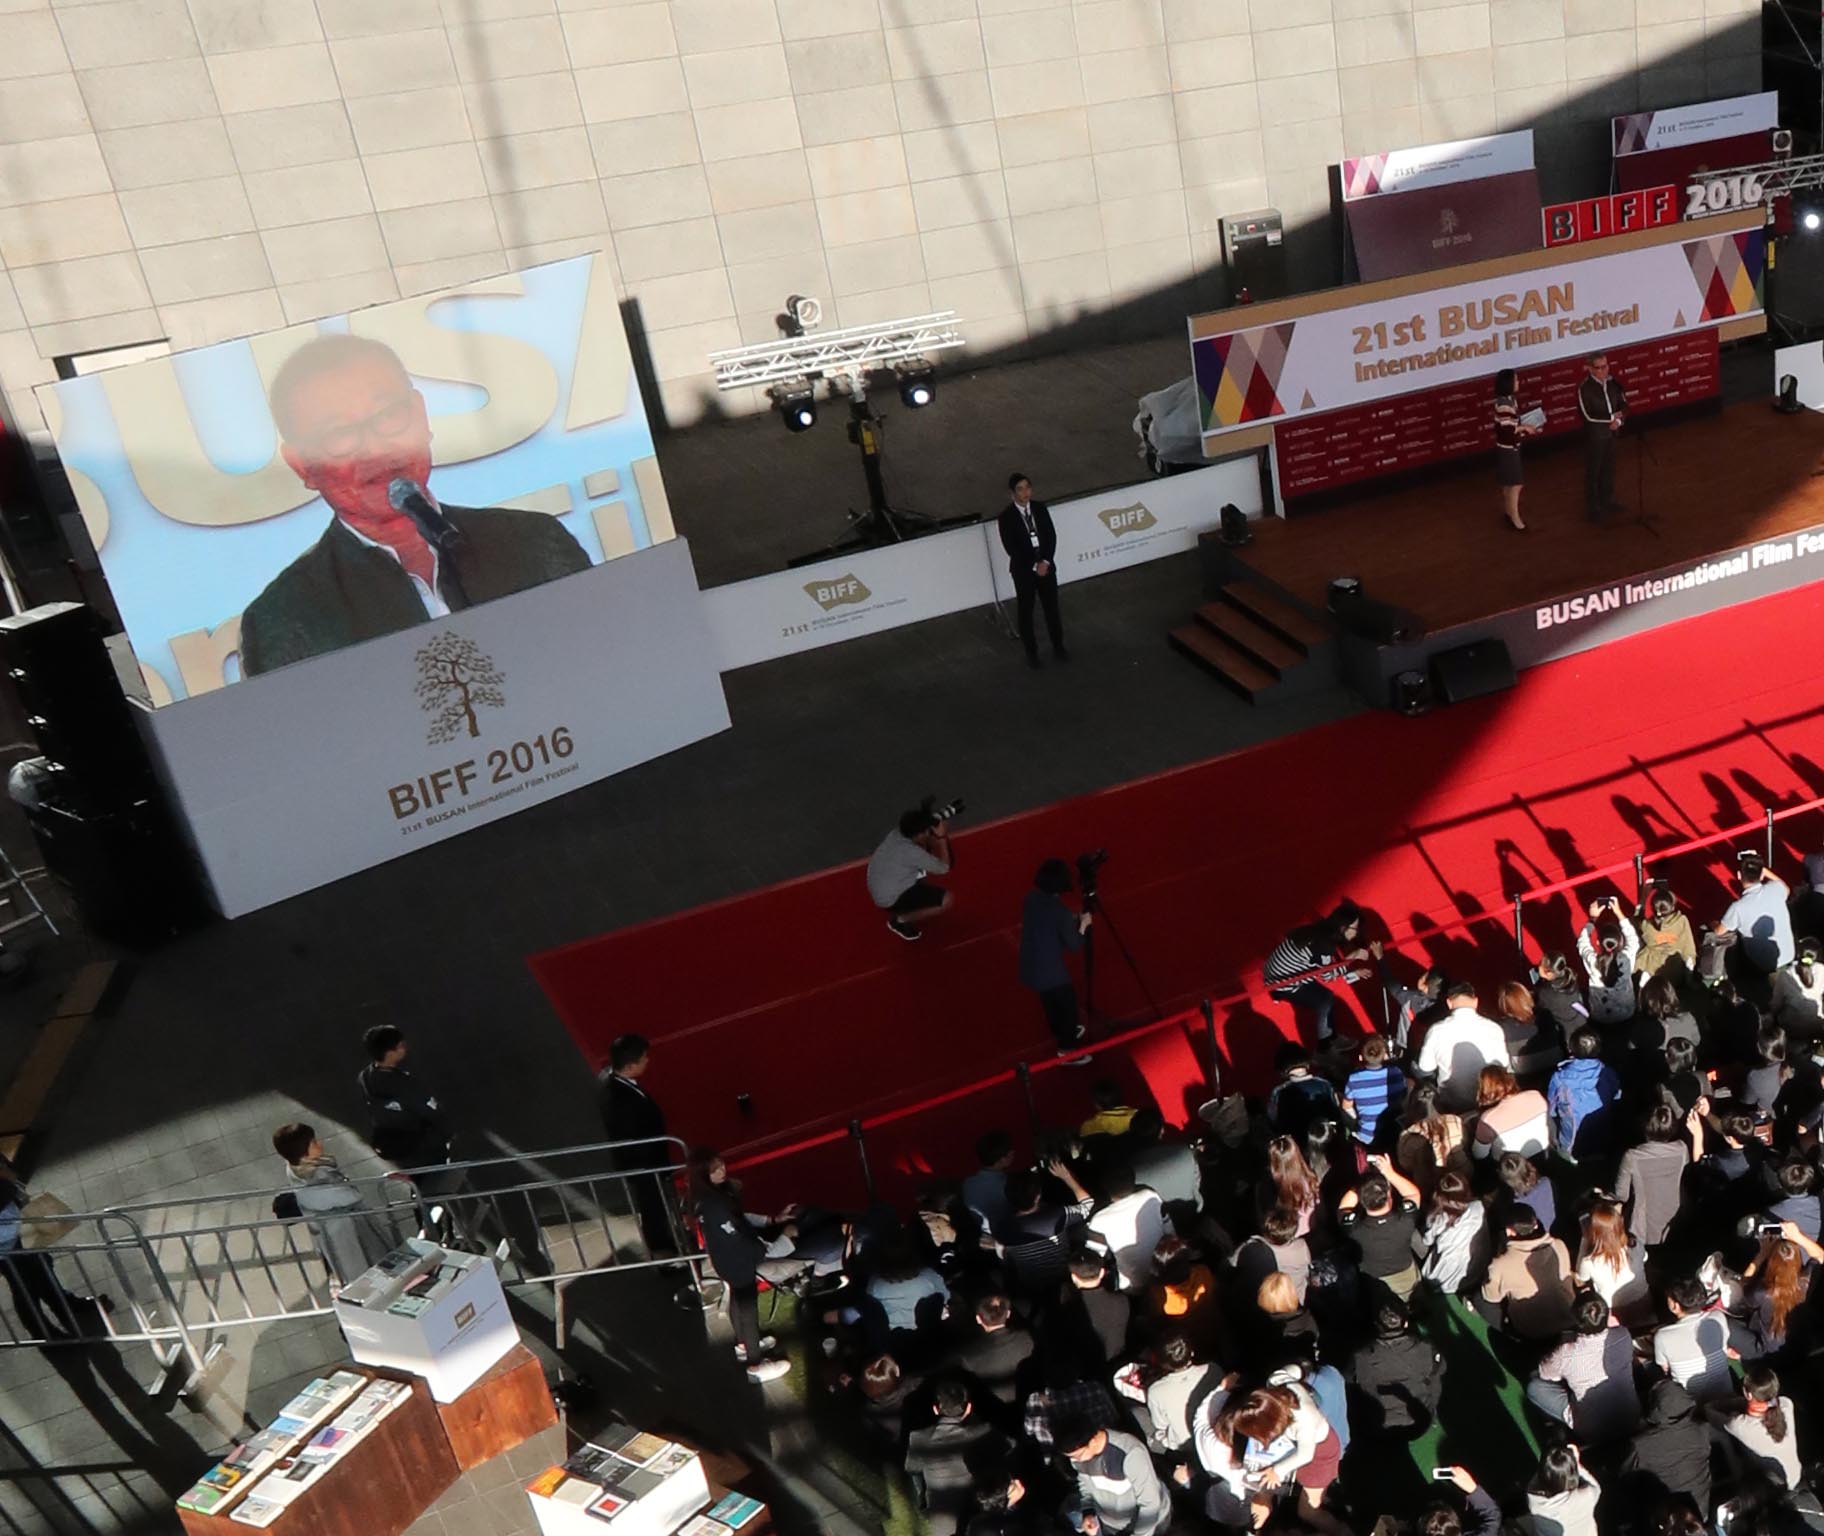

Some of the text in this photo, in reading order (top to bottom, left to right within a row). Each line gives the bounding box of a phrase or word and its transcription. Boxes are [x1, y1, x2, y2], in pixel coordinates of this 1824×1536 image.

[1551, 190, 1671, 241] BIFF
[1686, 173, 1764, 216] 2016
[1352, 281, 1575, 355] 21st BUSAN
[1355, 303, 1640, 384] International Film Festival
[1108, 508, 1146, 530] BIFF
[1077, 549, 1101, 562] 21st
[1536, 587, 1621, 630] BUSAN
[1625, 551, 1748, 605] International
[1752, 541, 1794, 569] Film
[816, 580, 858, 603] BIFF
[781, 623, 809, 638] 21st
[387, 726, 574, 820] BIFF 2016
[400, 762, 580, 836] 21st BUSAN International Film Festival
